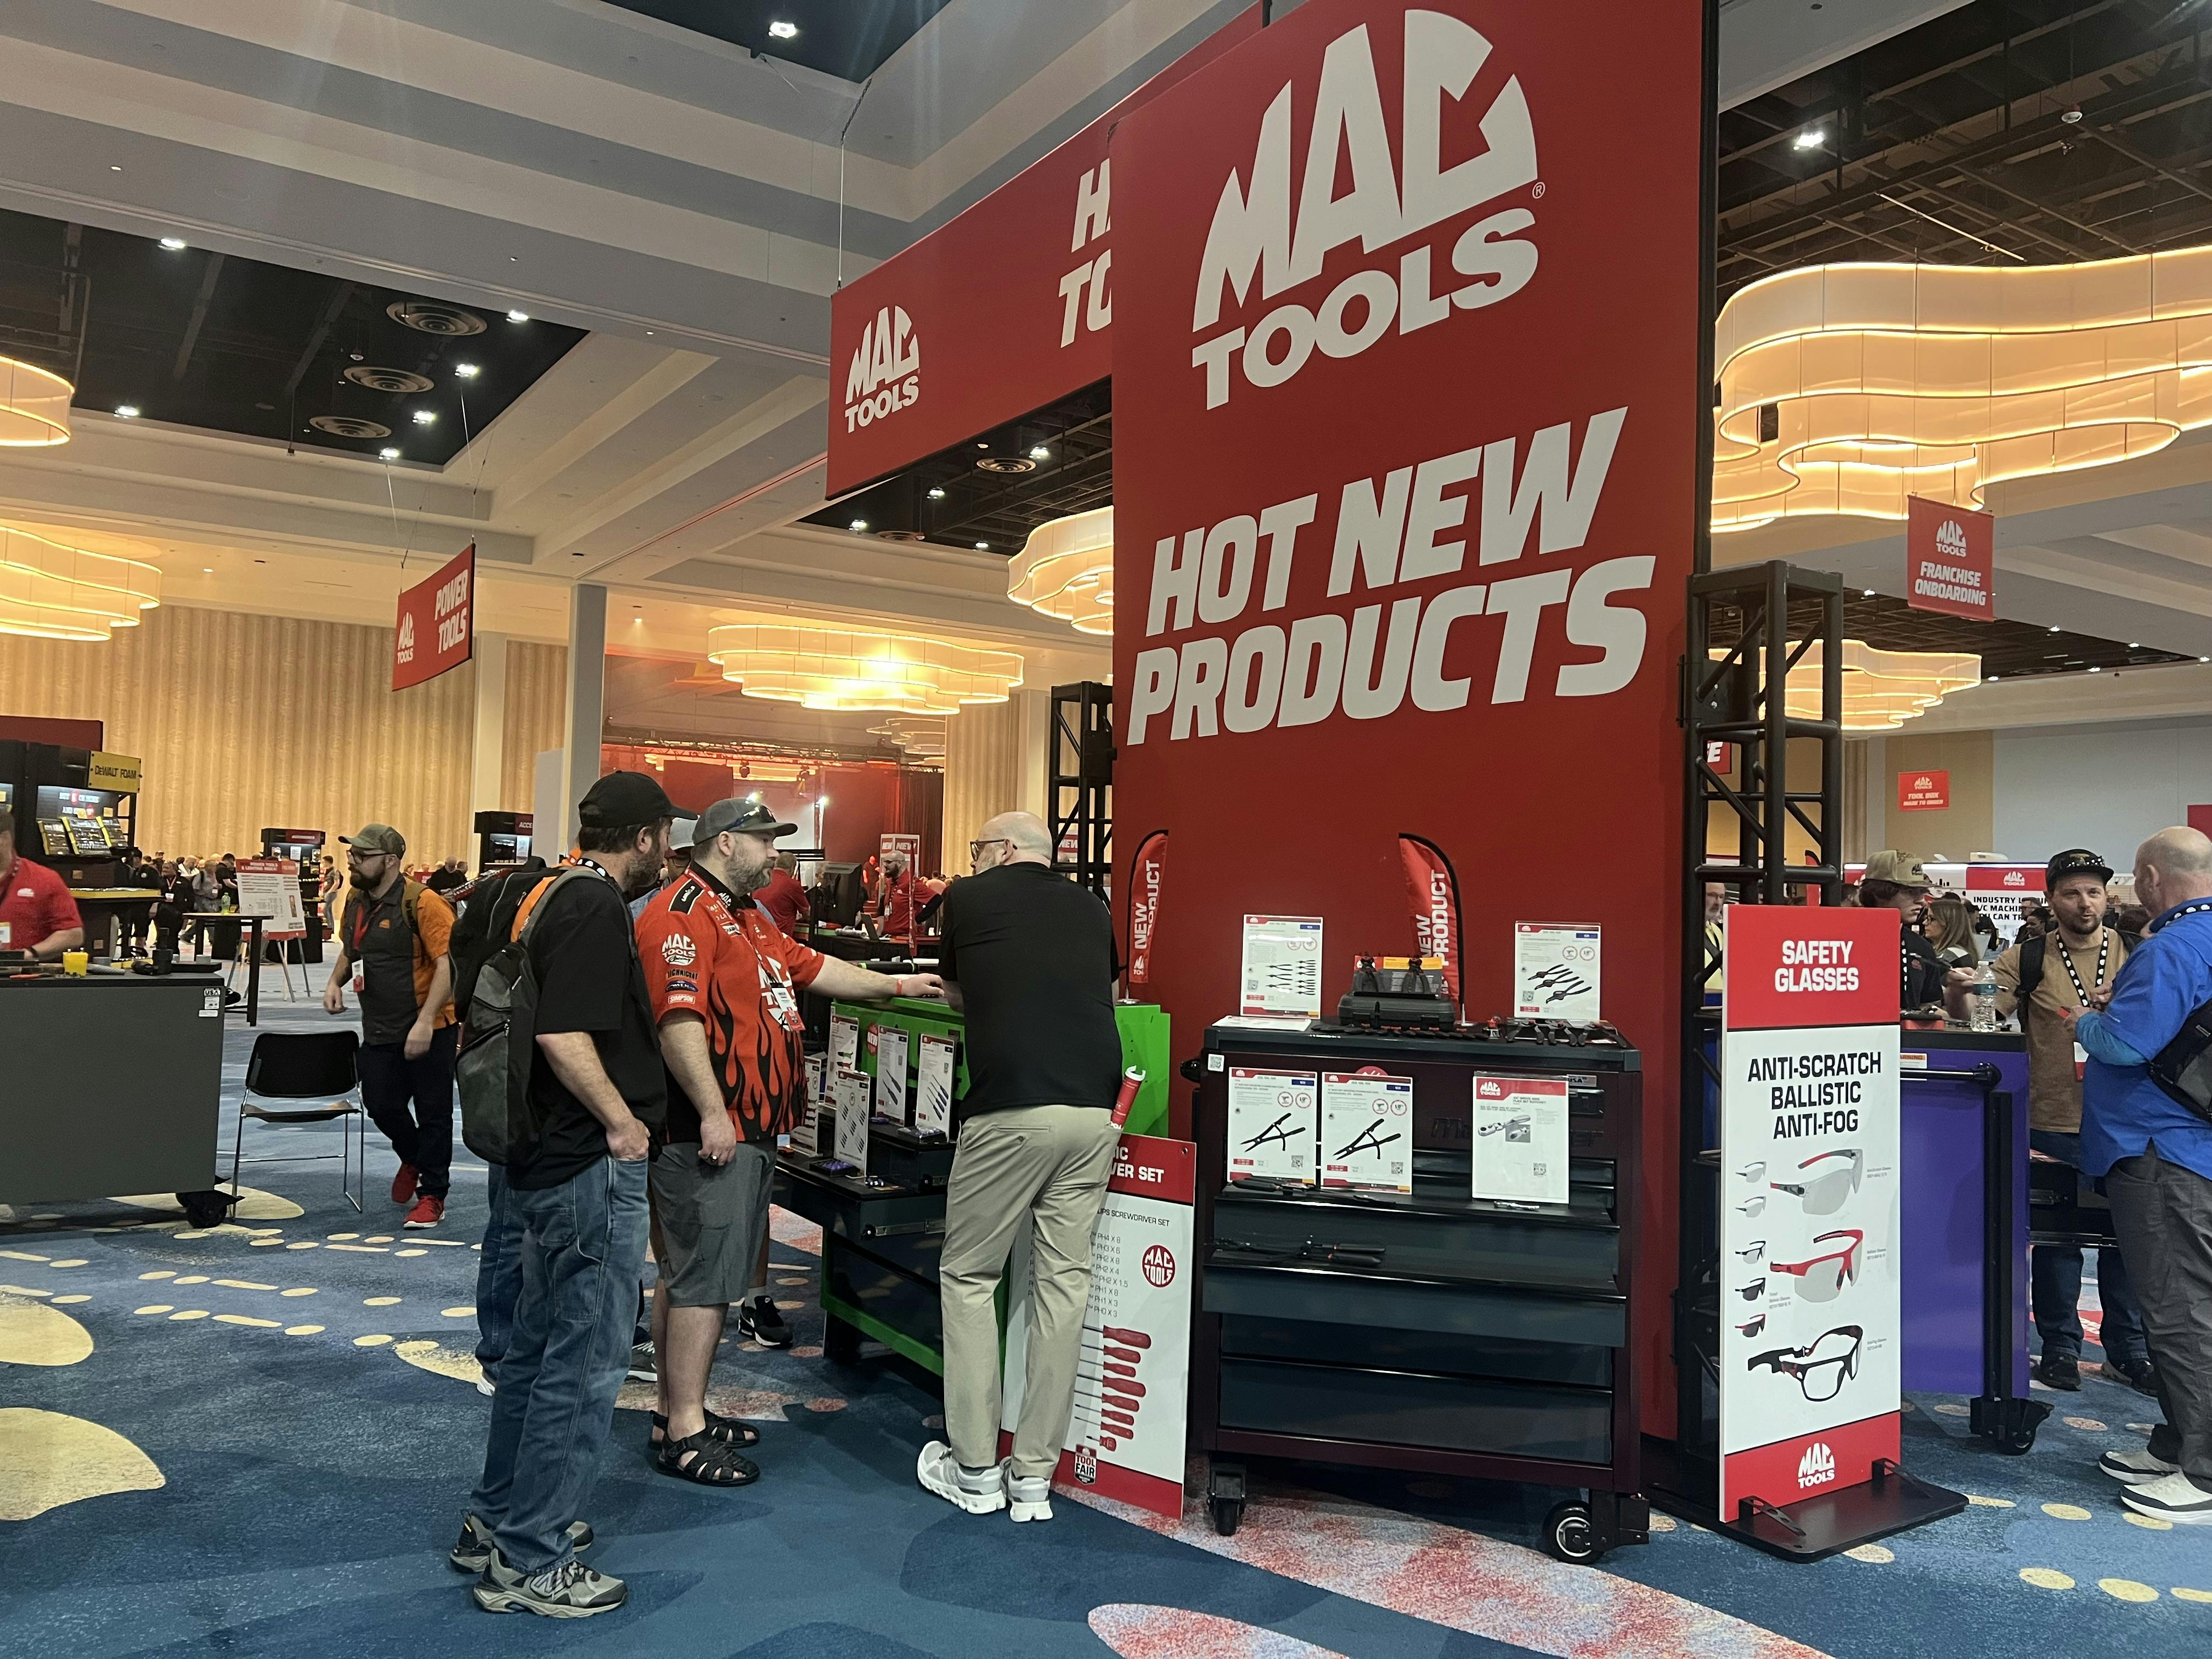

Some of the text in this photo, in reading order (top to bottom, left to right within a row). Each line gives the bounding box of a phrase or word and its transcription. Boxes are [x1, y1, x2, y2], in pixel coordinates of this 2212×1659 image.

[1193, 9, 1537, 332] MAC
[1071, 158, 1111, 252] H
[1192, 208, 1539, 409] TOOLS
[845, 306, 919, 404] MAC
[845, 375, 919, 433] TOOLS
[1146, 407, 1628, 636] HOT NEW
[1937, 521, 1966, 548] MAC
[1936, 543, 1966, 557] TOOLS
[1921, 561, 1981, 586] FRANCHISE
[435, 569, 468, 621] POWER
[1915, 579, 1987, 606] ONBOARDING
[398, 612, 414, 650] MAC
[438, 607, 467, 654] TOOLS
[398, 647, 413, 664] TOOLS
[1127, 555, 1656, 746] PRODUCTS
[1707, 742, 1723, 763] E
[120, 769, 137, 779] FOAM
[2003, 871, 2025, 882] MAC
[1135, 902, 1147, 949] NEW
[1431, 870, 1449, 966] PRODUCT
[662, 933, 696, 952] MAC
[662, 949, 696, 958] TOOLS
[1782, 940, 1853, 964] SAFETY
[1775, 967, 1859, 992] GLASSES
[1748, 1052, 1881, 1082] ANTI-SCRATCH
[1480, 1081, 1500, 1092] MAC
[1771, 1081, 1861, 1109] BALLISTIC
[1773, 1109, 1859, 1139] ANTI-FOG
[1114, 1146, 1128, 1160] IC
[1138, 1166, 1164, 1183] SET
[1111, 1210, 1156, 1224] SCREWDRIVER
[1158, 1218, 1170, 1227] SET
[1144, 1248, 1172, 1268] MAC
[1144, 1265, 1173, 1285] TOOLS
[1076, 1454, 1095, 1467] TOOL
[1076, 1463, 1095, 1477] FAIR
[1798, 1442, 1835, 1477] MAC
[1798, 1469, 1835, 1488] TOOLS
